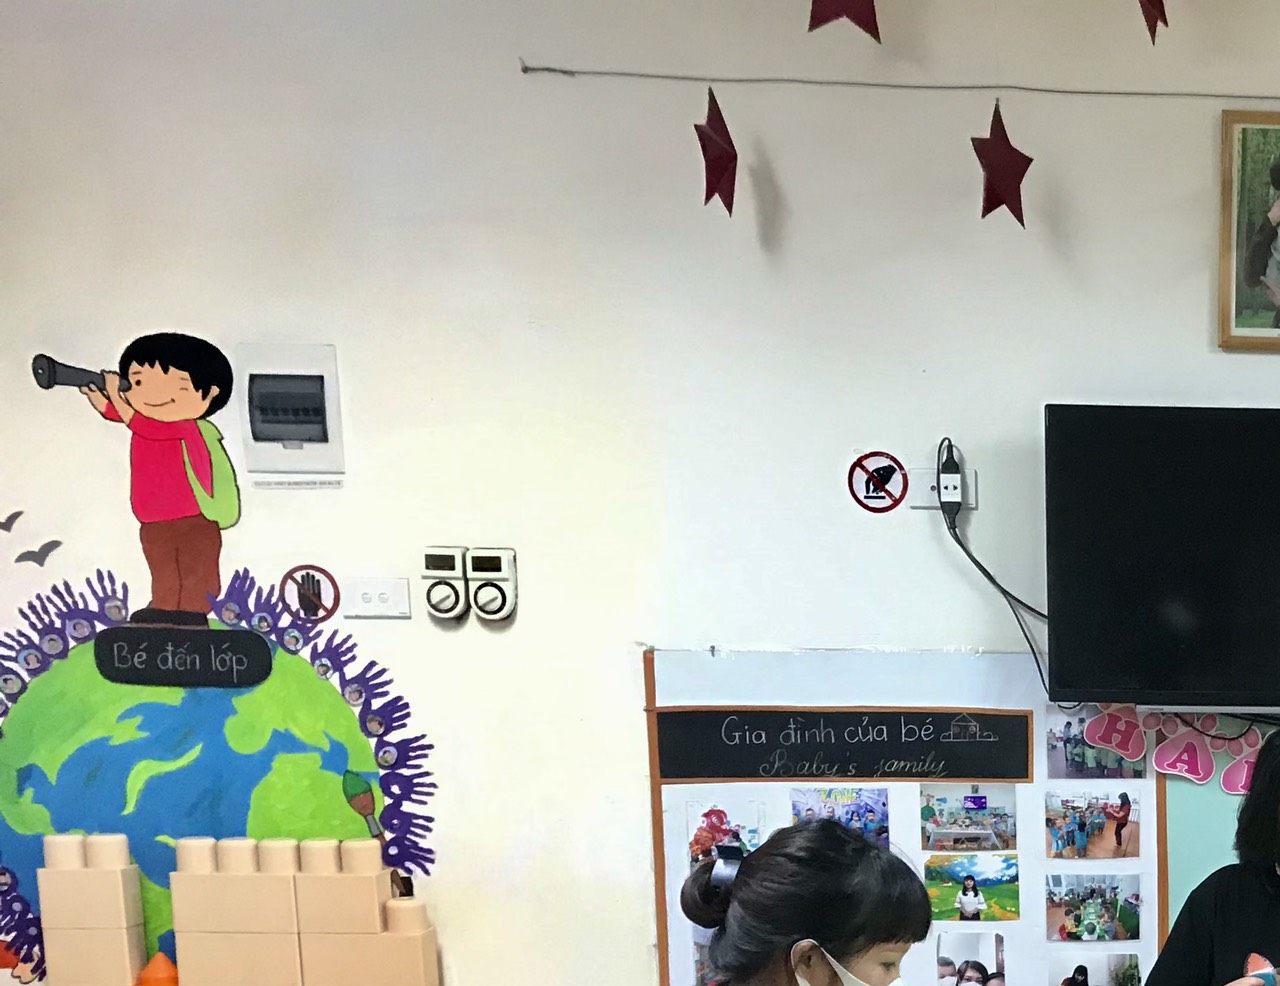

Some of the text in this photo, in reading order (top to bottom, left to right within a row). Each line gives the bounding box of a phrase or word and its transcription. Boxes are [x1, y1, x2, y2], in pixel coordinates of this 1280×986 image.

[113, 641, 249, 684] Bé đến lớp
[721, 715, 935, 746] Gia đình của bé
[759, 749, 858, 778] Baby's
